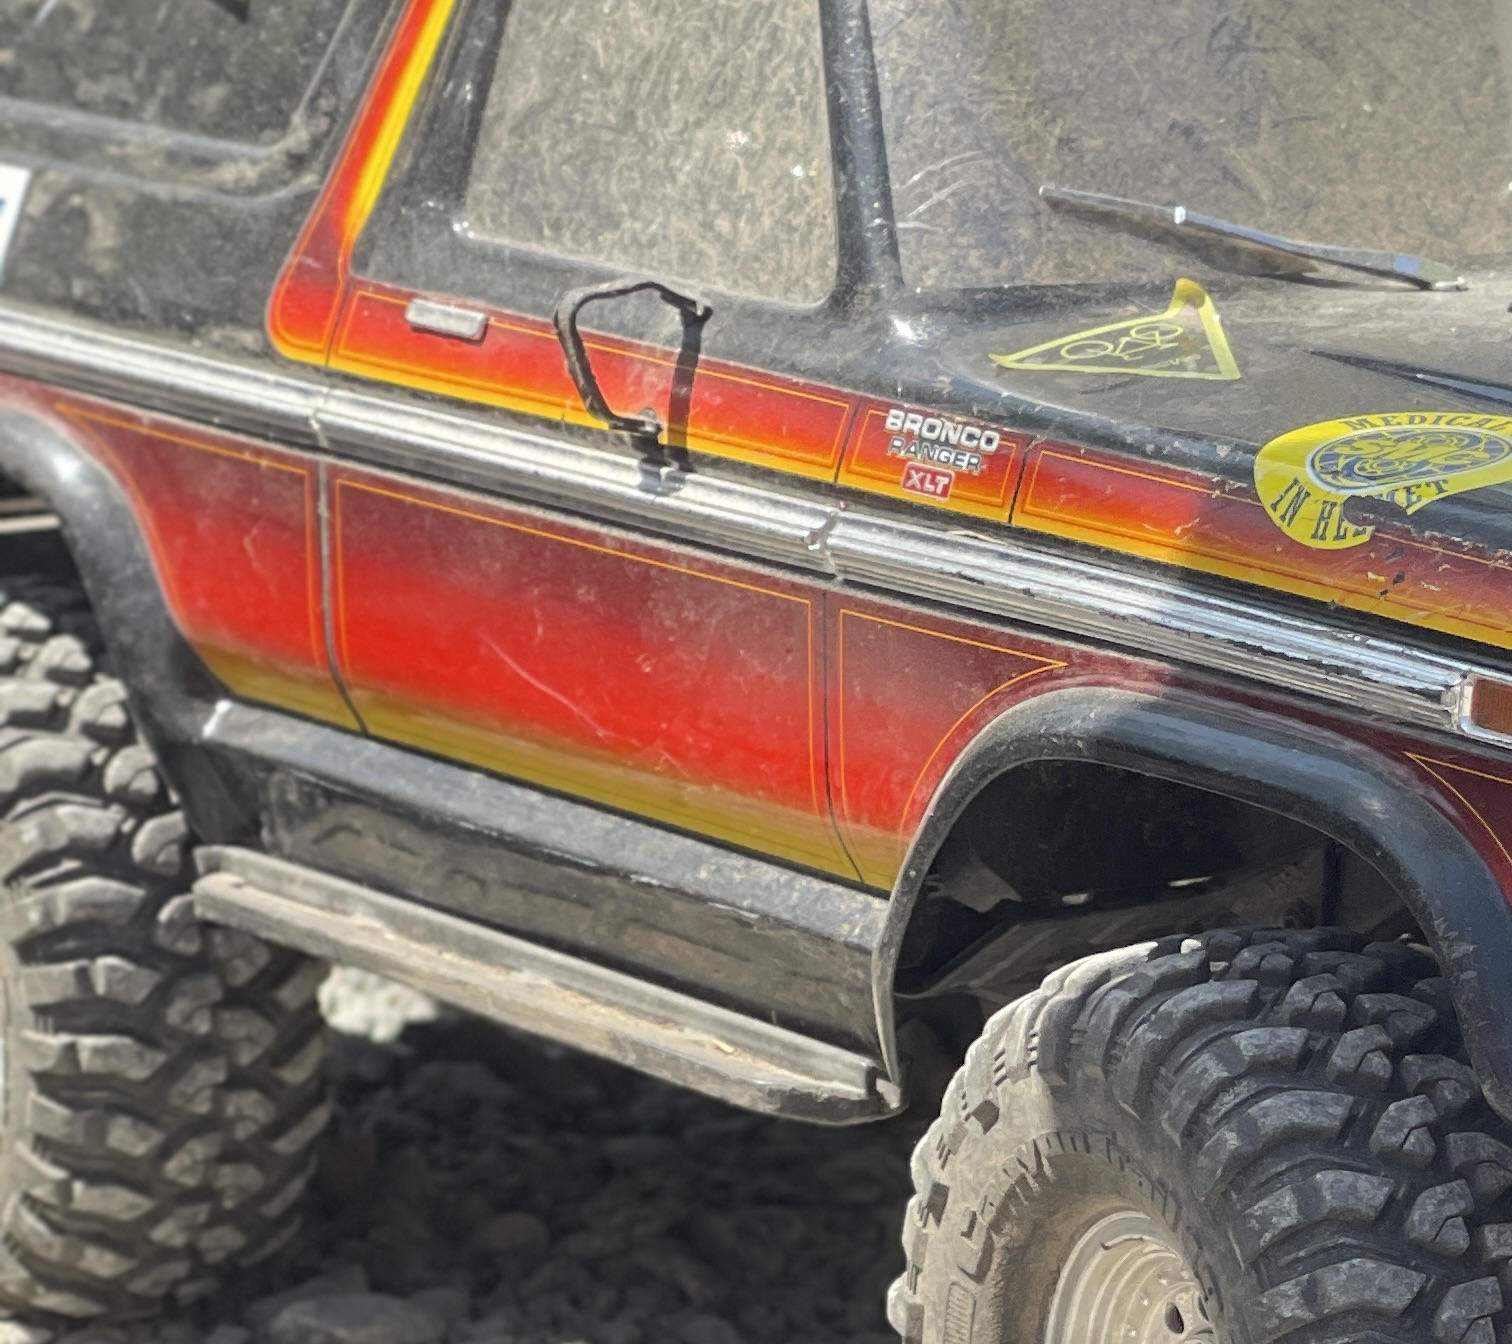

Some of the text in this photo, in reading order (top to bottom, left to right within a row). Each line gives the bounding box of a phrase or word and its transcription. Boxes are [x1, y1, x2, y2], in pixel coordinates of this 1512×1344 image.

[885, 409, 1000, 453] BRONCO
[886, 436, 983, 476] RANGER
[905, 469, 950, 494] XLT
[1270, 476, 1449, 542] IN HEET
